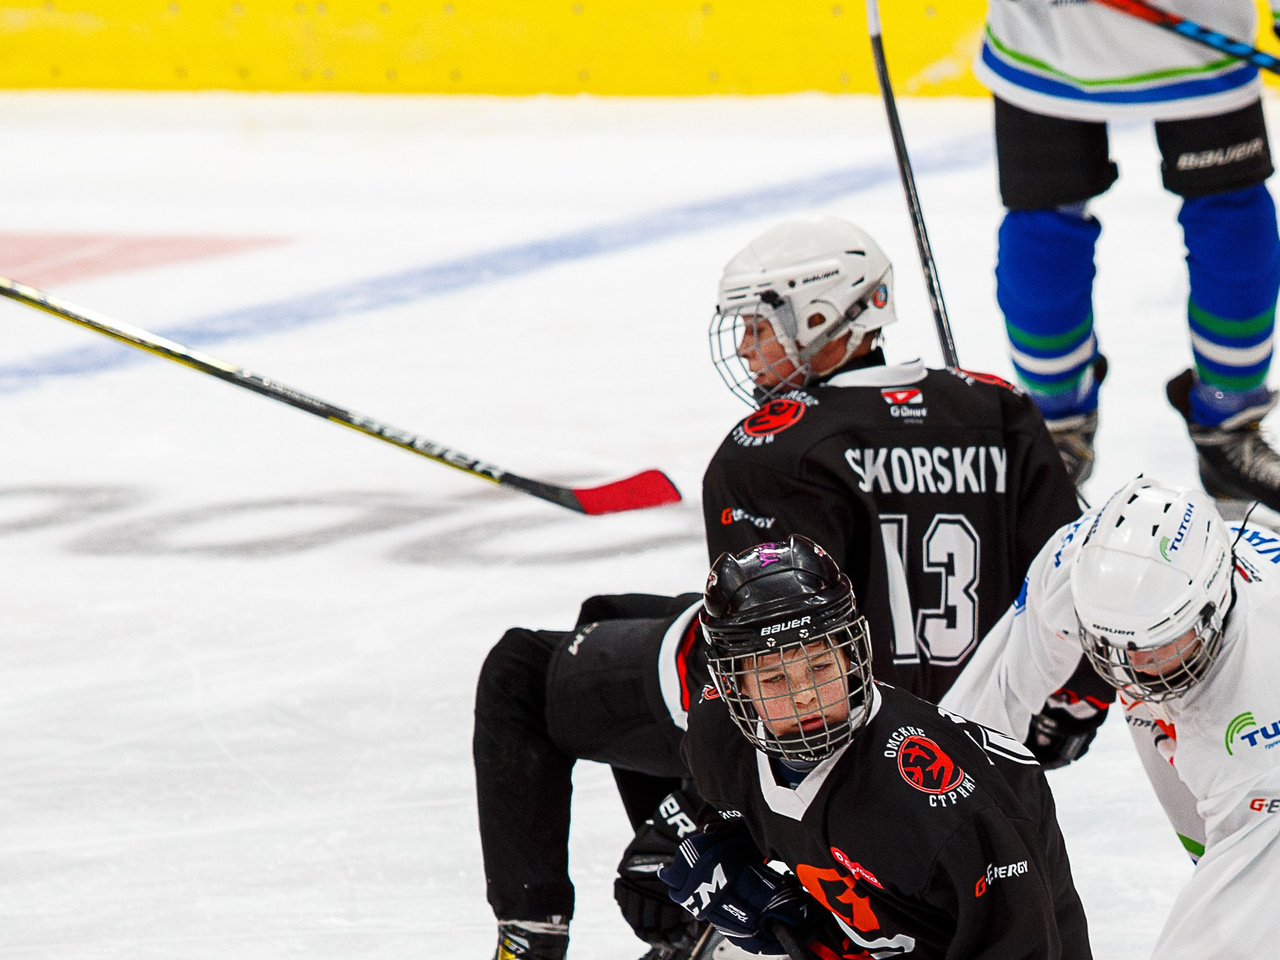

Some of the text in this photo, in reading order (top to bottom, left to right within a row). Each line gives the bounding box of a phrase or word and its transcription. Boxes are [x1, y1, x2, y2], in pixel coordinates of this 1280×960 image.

[879, 513, 982, 667] 13
[760, 616, 812, 637] BAUER
[884, 725, 926, 758] ОМСКИЕ
